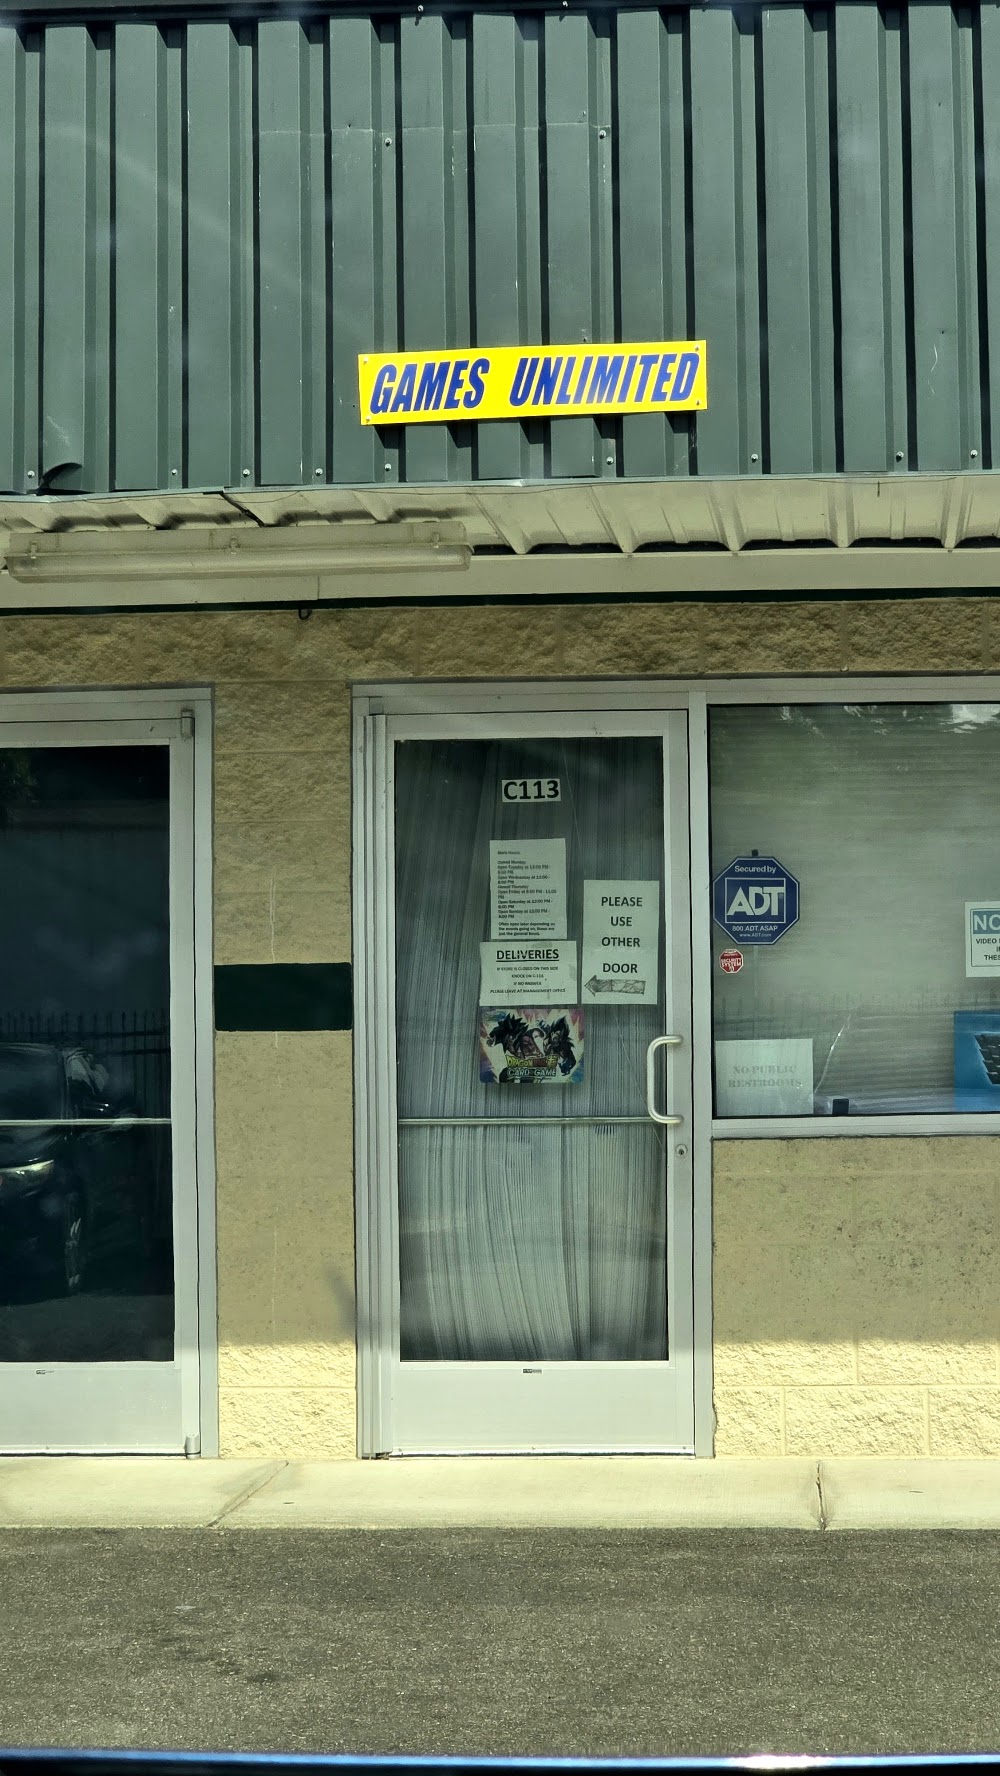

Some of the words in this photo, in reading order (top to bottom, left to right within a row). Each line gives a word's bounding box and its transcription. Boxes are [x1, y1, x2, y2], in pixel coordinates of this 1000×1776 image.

[369, 357, 490, 415] GAMES
[509, 352, 700, 407] UNLIMITED
[503, 780, 560, 800] C113
[734, 865, 766, 873] Secured
[767, 865, 777, 874] by
[601, 896, 643, 907] PLEASE
[726, 886, 785, 916] ADT
[610, 916, 633, 927] USE
[601, 937, 641, 948] OTHER
[497, 949, 559, 960] DELIVERIES
[602, 963, 638, 974] DOOR
[508, 1068, 530, 1076] CARD
[534, 1068, 557, 1076] GAME
[733, 1065, 750, 1075] NO
[751, 1064, 797, 1075] PUBLIC
[728, 1078, 802, 1088] RESTROOMS
